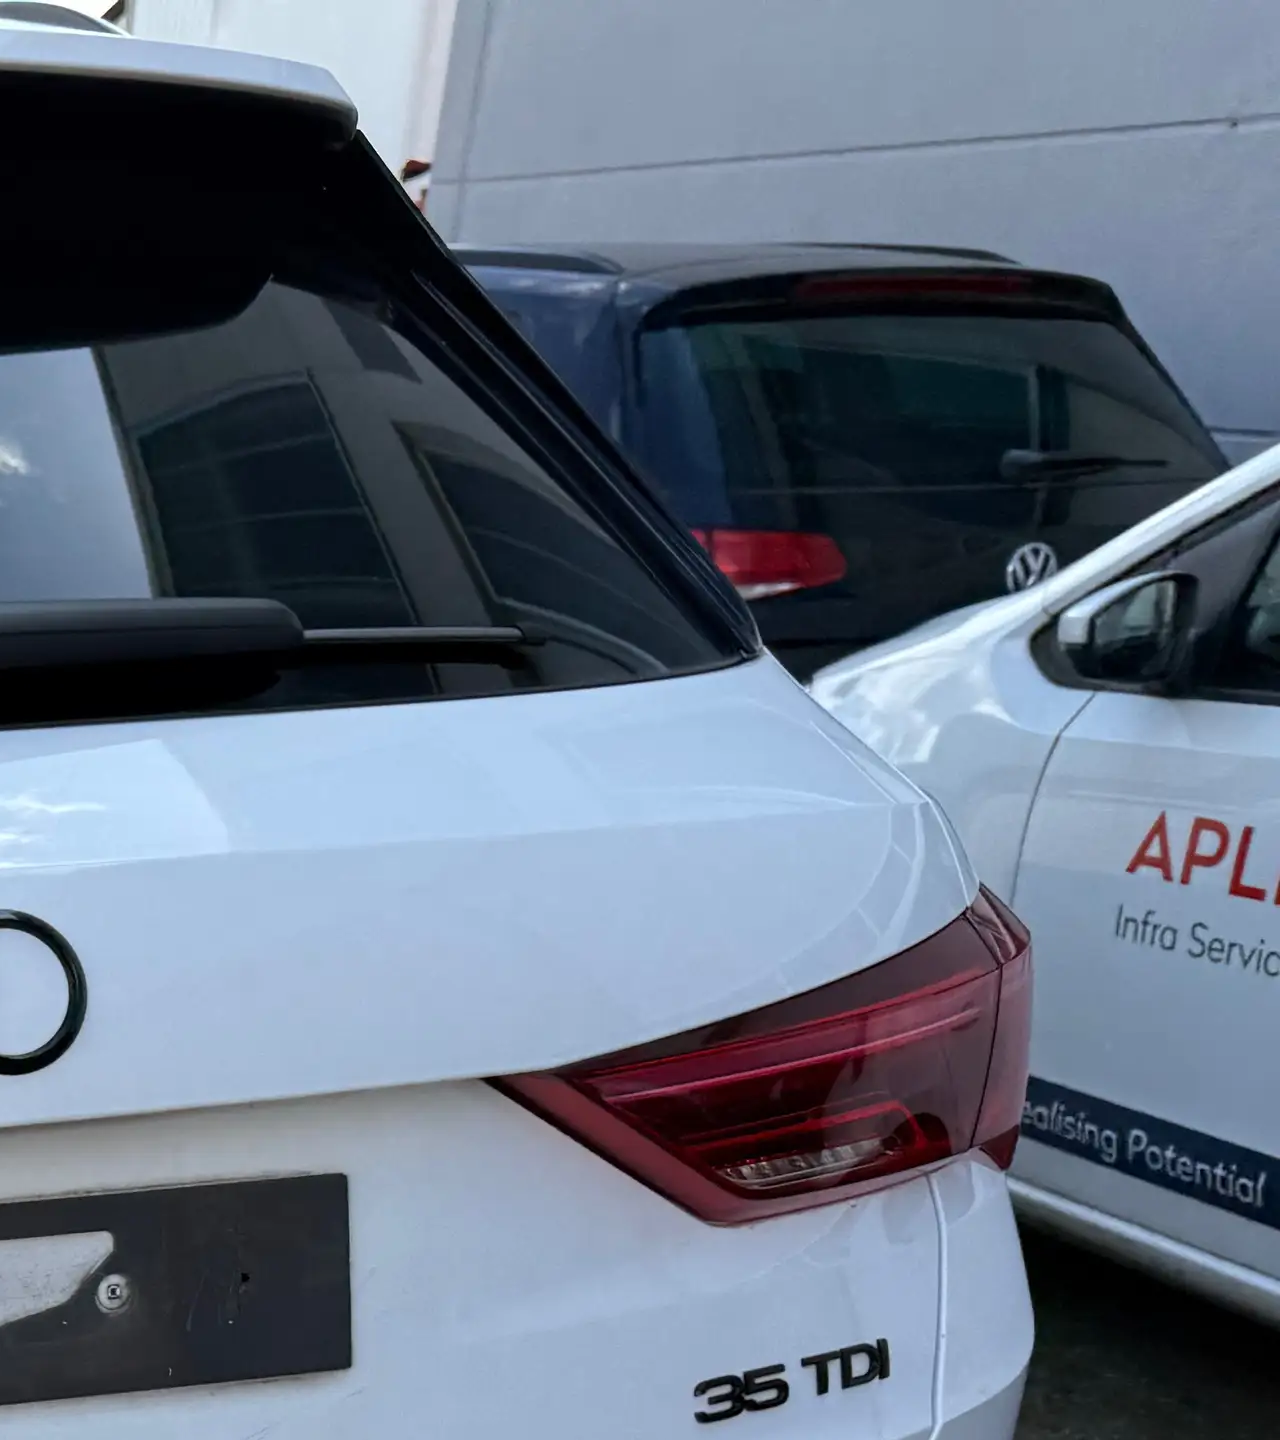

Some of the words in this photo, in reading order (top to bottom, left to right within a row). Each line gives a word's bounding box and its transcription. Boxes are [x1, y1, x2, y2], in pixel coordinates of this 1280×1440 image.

[1125, 810, 1280, 906] APL
[1114, 903, 1178, 951] Infra
[1128, 1129, 1267, 1206] Potential
[693, 1363, 790, 1424] 35
[800, 1338, 891, 1396] TDI
